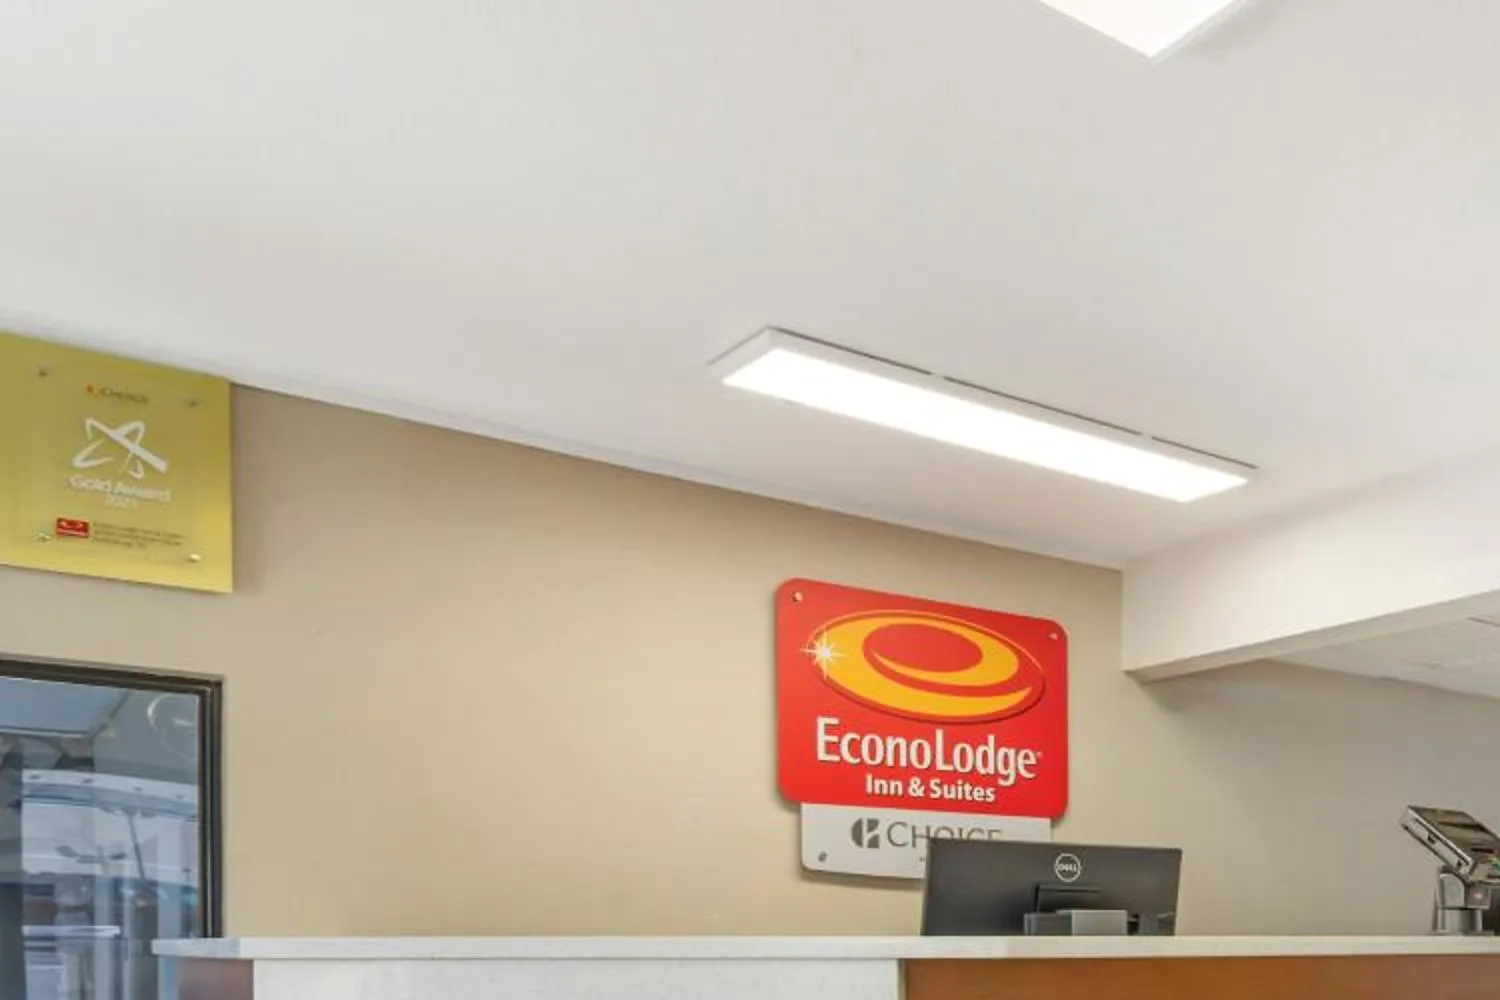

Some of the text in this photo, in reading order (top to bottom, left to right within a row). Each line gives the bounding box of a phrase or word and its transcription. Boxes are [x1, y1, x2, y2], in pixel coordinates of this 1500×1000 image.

[866, 774, 996, 802] Inn & Suites
